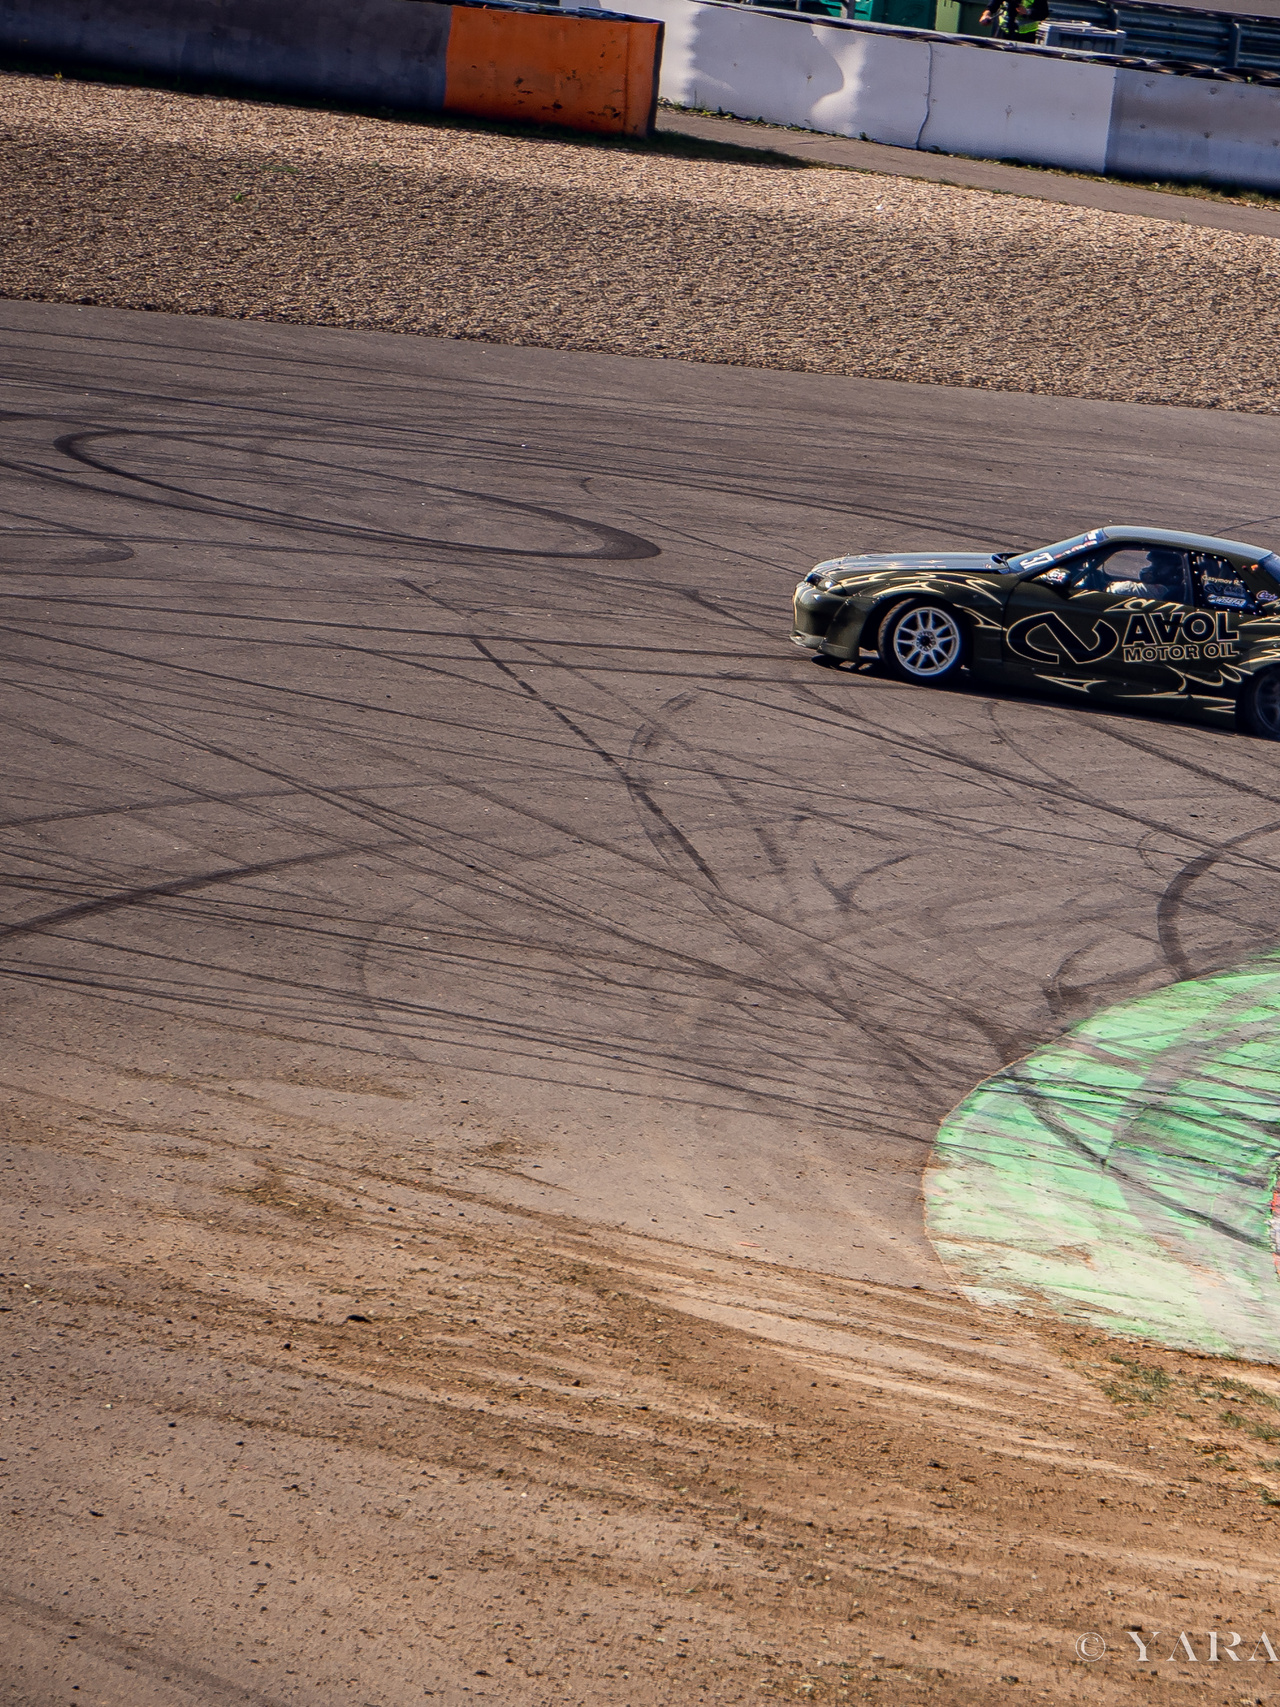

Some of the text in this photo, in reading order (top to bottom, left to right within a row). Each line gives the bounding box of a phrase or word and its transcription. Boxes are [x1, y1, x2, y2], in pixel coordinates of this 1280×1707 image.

[1122, 611, 1239, 647] AVOL
[1124, 642, 1240, 662] MOTOR OIL
